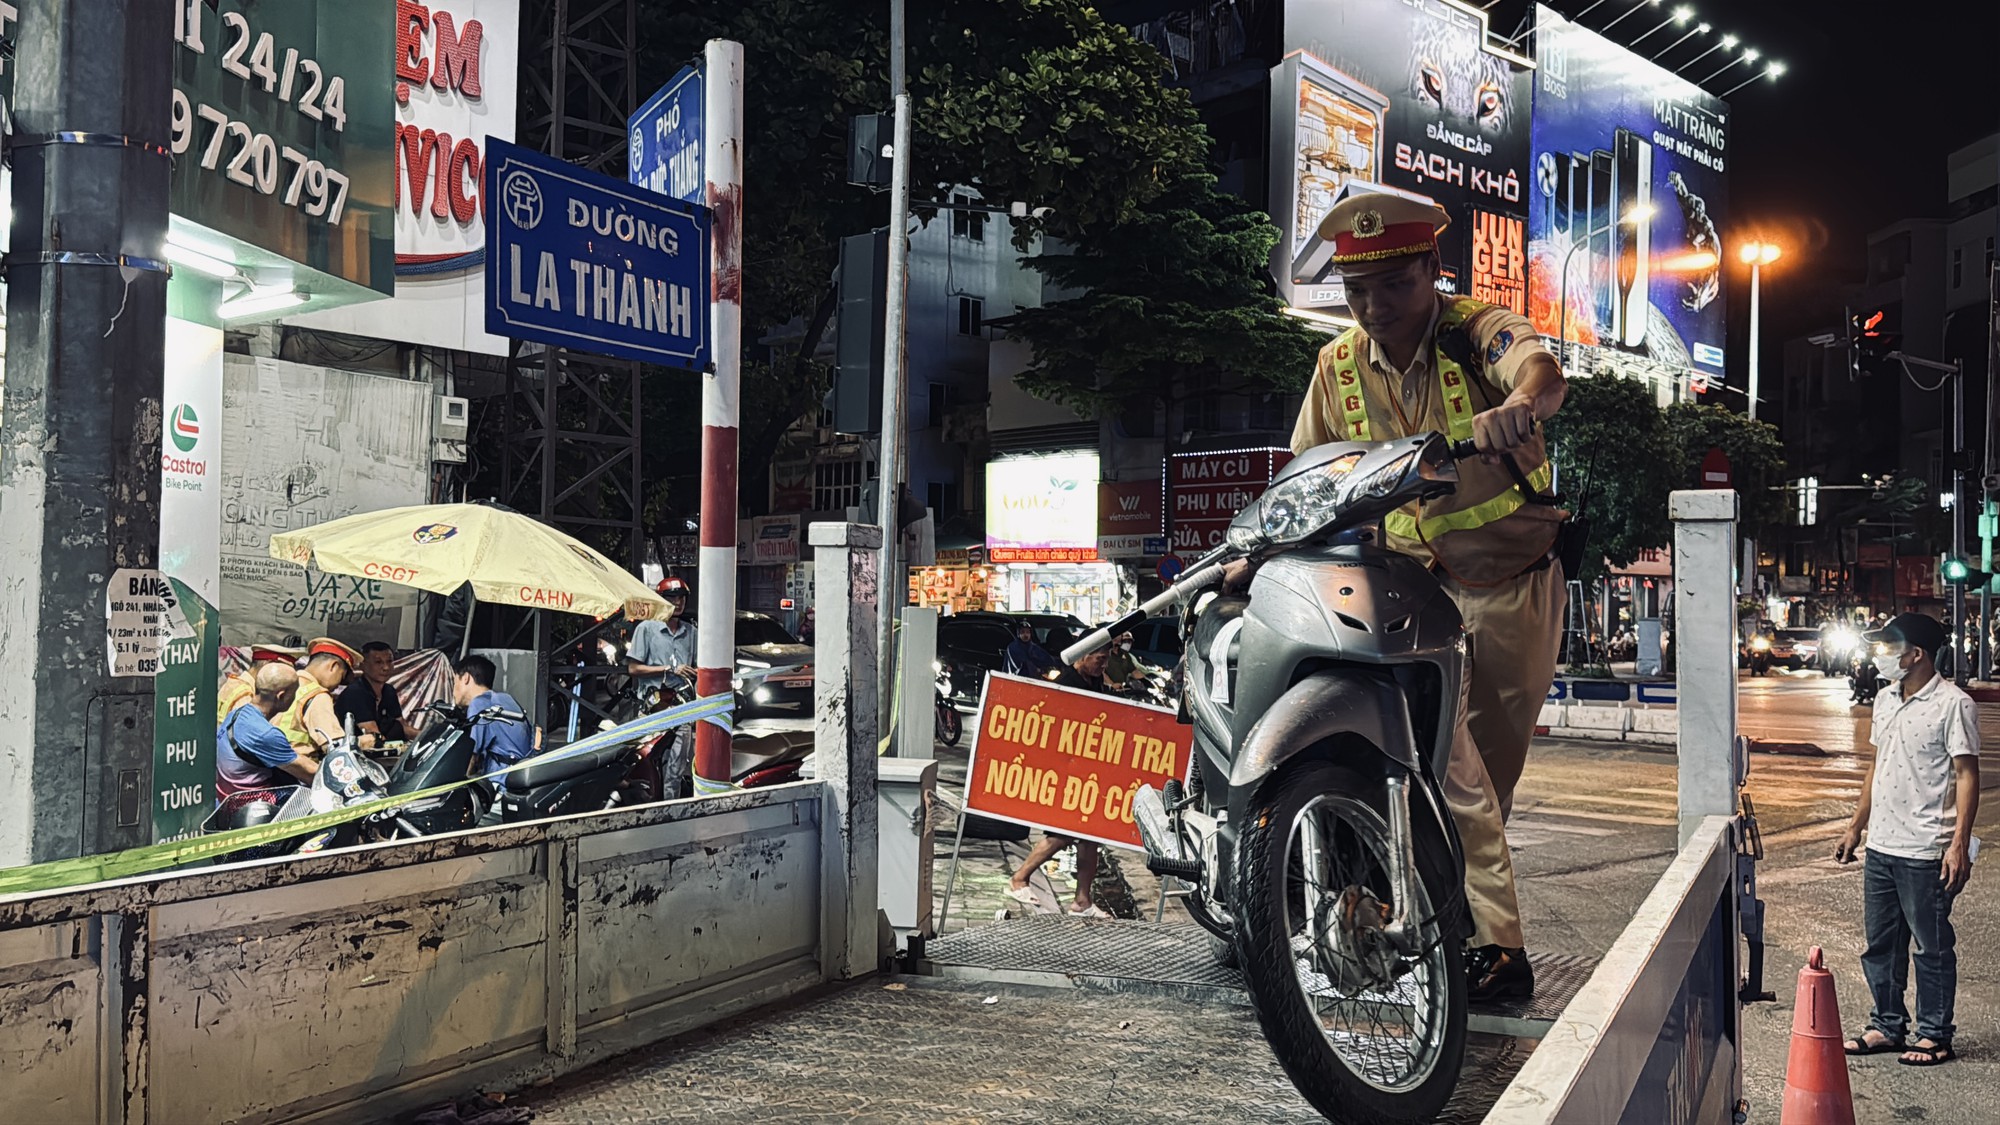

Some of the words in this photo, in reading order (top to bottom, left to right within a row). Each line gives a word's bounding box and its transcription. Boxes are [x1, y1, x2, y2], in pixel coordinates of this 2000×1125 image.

[222, 12, 347, 132] 24/24
[1544, 74, 1567, 100] BOSS
[656, 89, 681, 142] PHỐ
[1682, 112, 1725, 151] TRĂNG
[396, 121, 486, 225] VIC
[1395, 143, 1464, 187] SẠCH
[1471, 167, 1520, 203] KHÔ
[567, 198, 679, 256] ĐƯỜNG
[510, 243, 561, 312] LA
[570, 258, 691, 339] THÀNH
[1310, 290, 1345, 302] LEOPA
[161, 454, 206, 476] Castrol
[1182, 456, 1220, 479] MÁY
[1223, 455, 1250, 477] CŨ
[166, 477, 181, 489] Bike
[183, 479, 202, 492] Point
[1109, 511, 1151, 521] vietnamobile
[1177, 493, 1209, 515] PHỤ
[1174, 524, 1202, 547] SỬA
[129, 574, 159, 596] BÁN
[363, 562, 419, 583] CSGT
[520, 586, 573, 608] CAHN
[164, 643, 201, 665] THAY
[167, 688, 196, 718] THẾ
[988, 700, 1056, 749] CHỐT
[1057, 712, 1126, 765] KIỂM
[1130, 734, 1177, 777] TRA
[166, 740, 197, 766] PHỤ
[161, 783, 202, 811] TÙNG
[984, 752, 1059, 807] NỒNG
[1062, 773, 1099, 823] ĐỘ
[1103, 778, 1142, 824] CỒ
